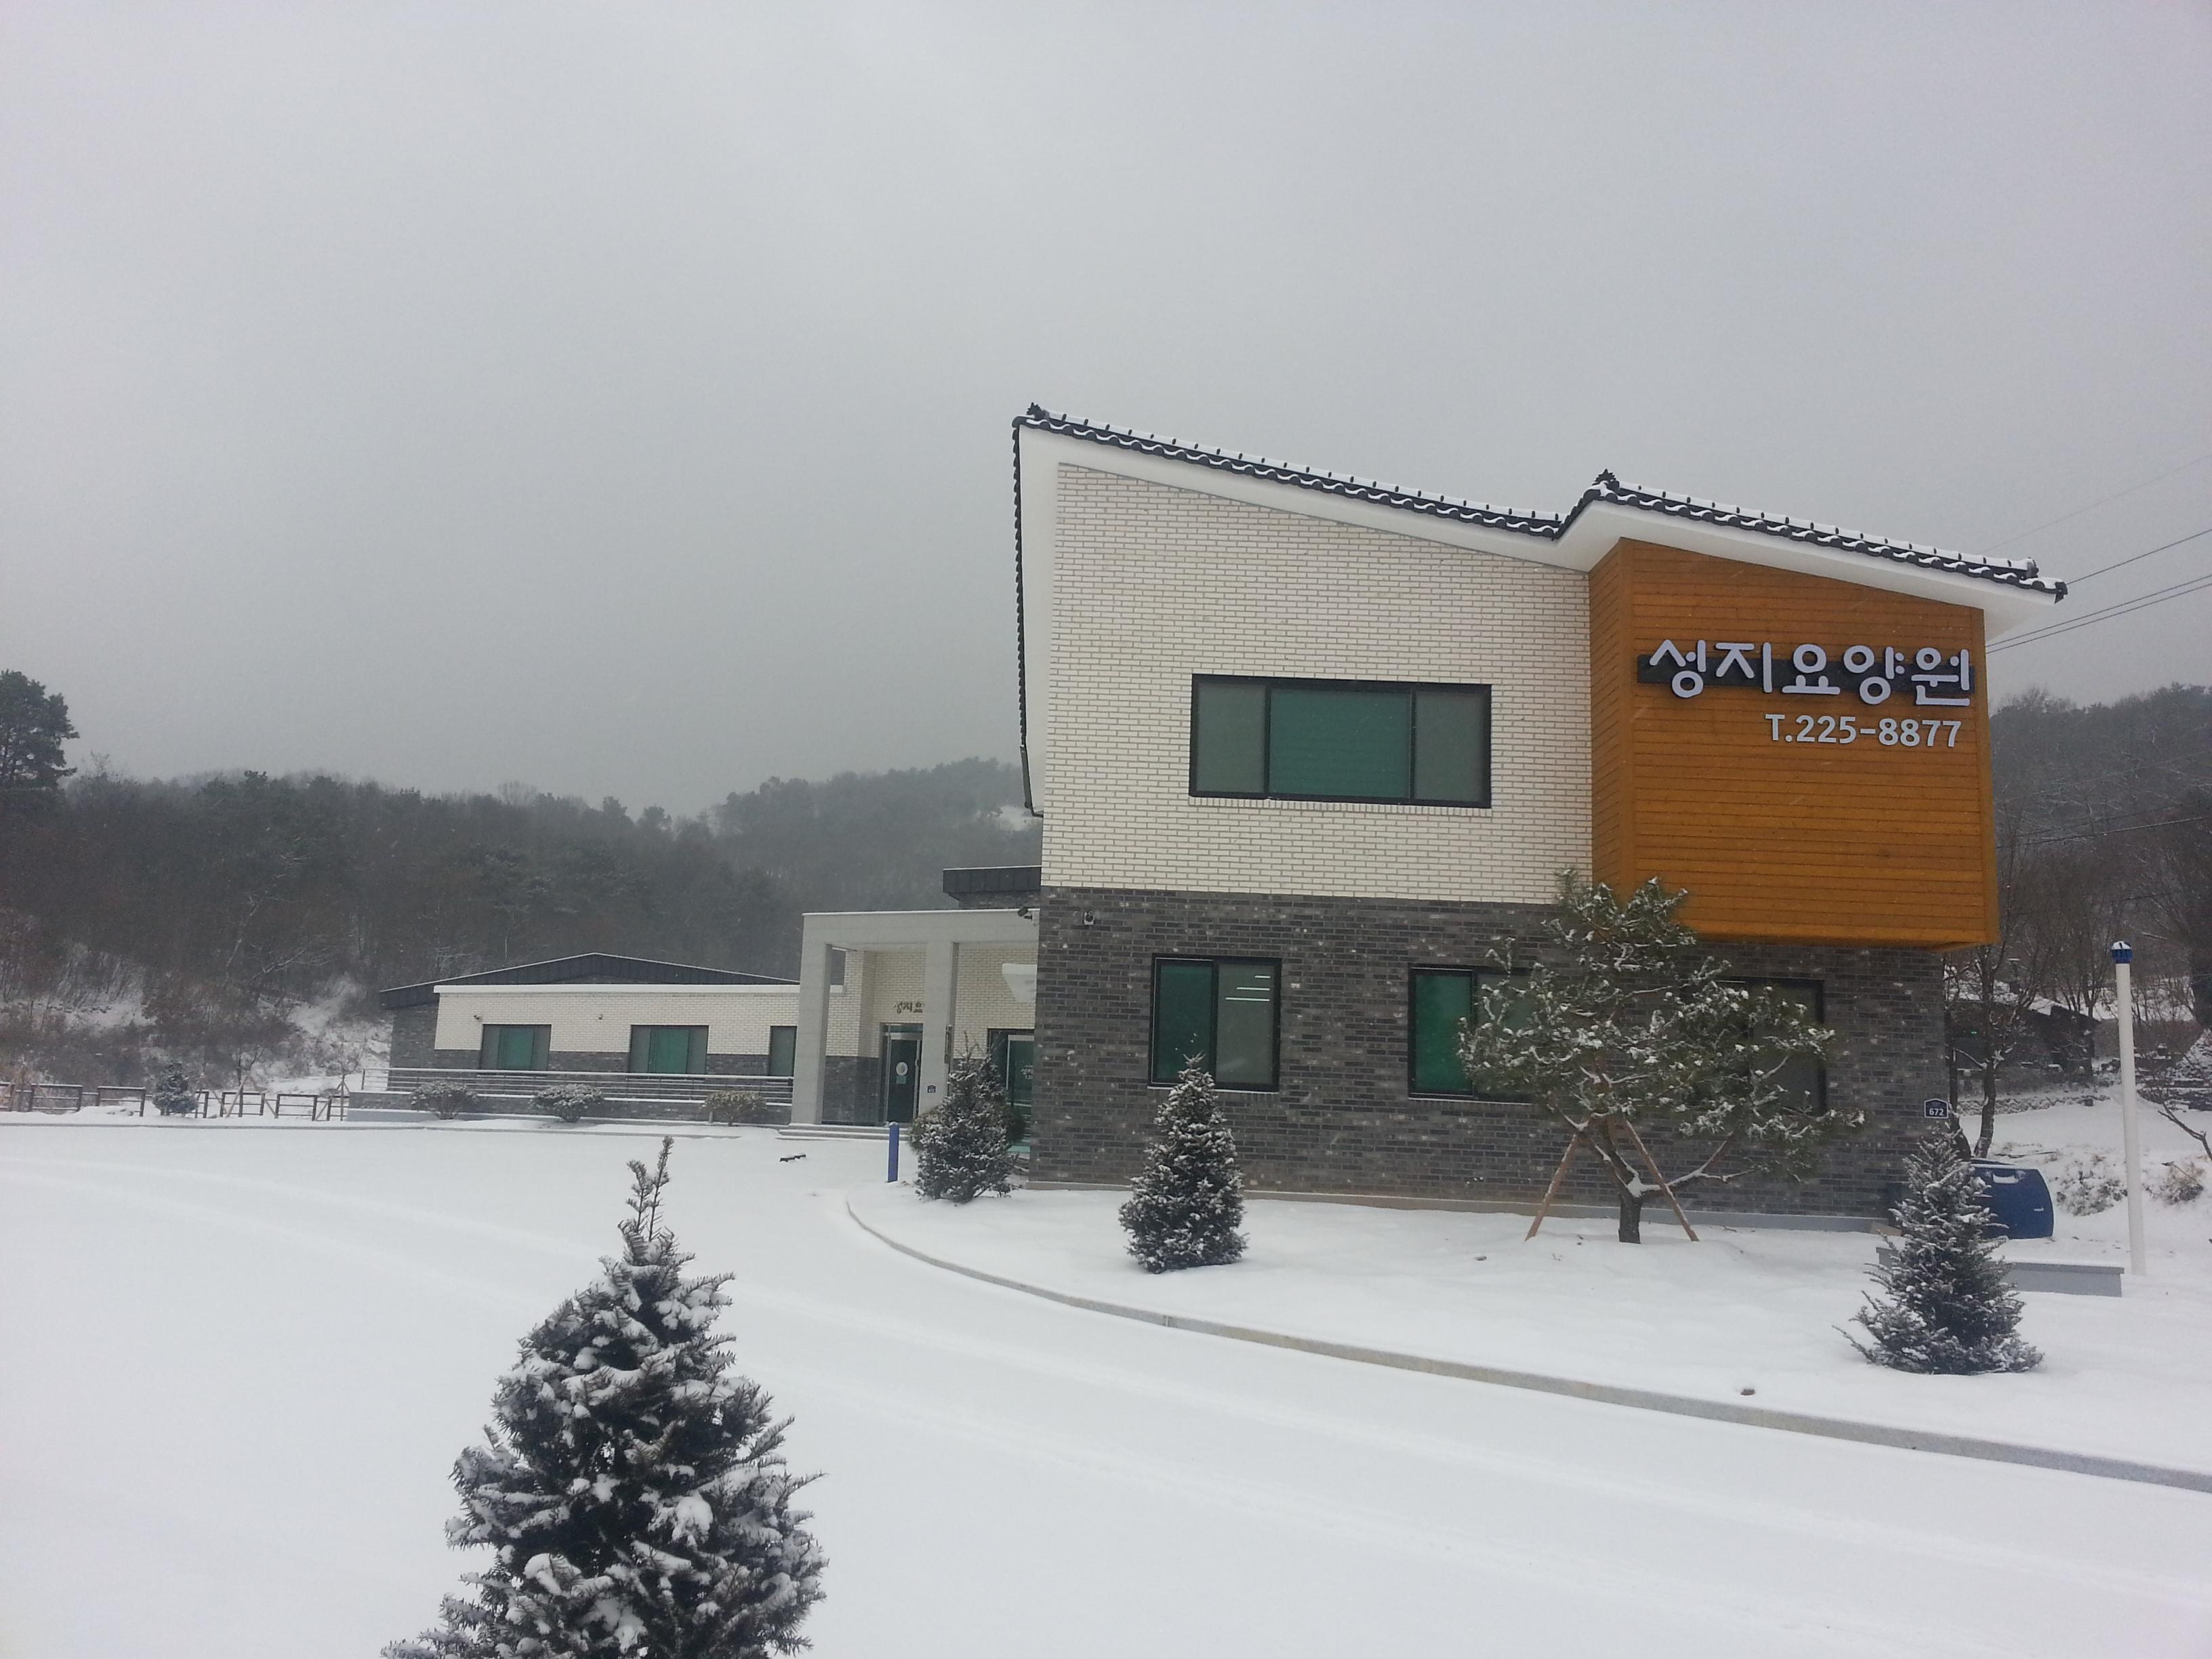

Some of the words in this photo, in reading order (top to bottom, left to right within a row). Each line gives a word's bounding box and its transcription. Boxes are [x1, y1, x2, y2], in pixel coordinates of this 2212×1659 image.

[1649, 639, 1971, 706] 성지요양원
[1765, 714, 1962, 747] T.225-8877
[894, 1001, 924, 1014] 성지요
[1929, 1107, 1944, 1116] 672
